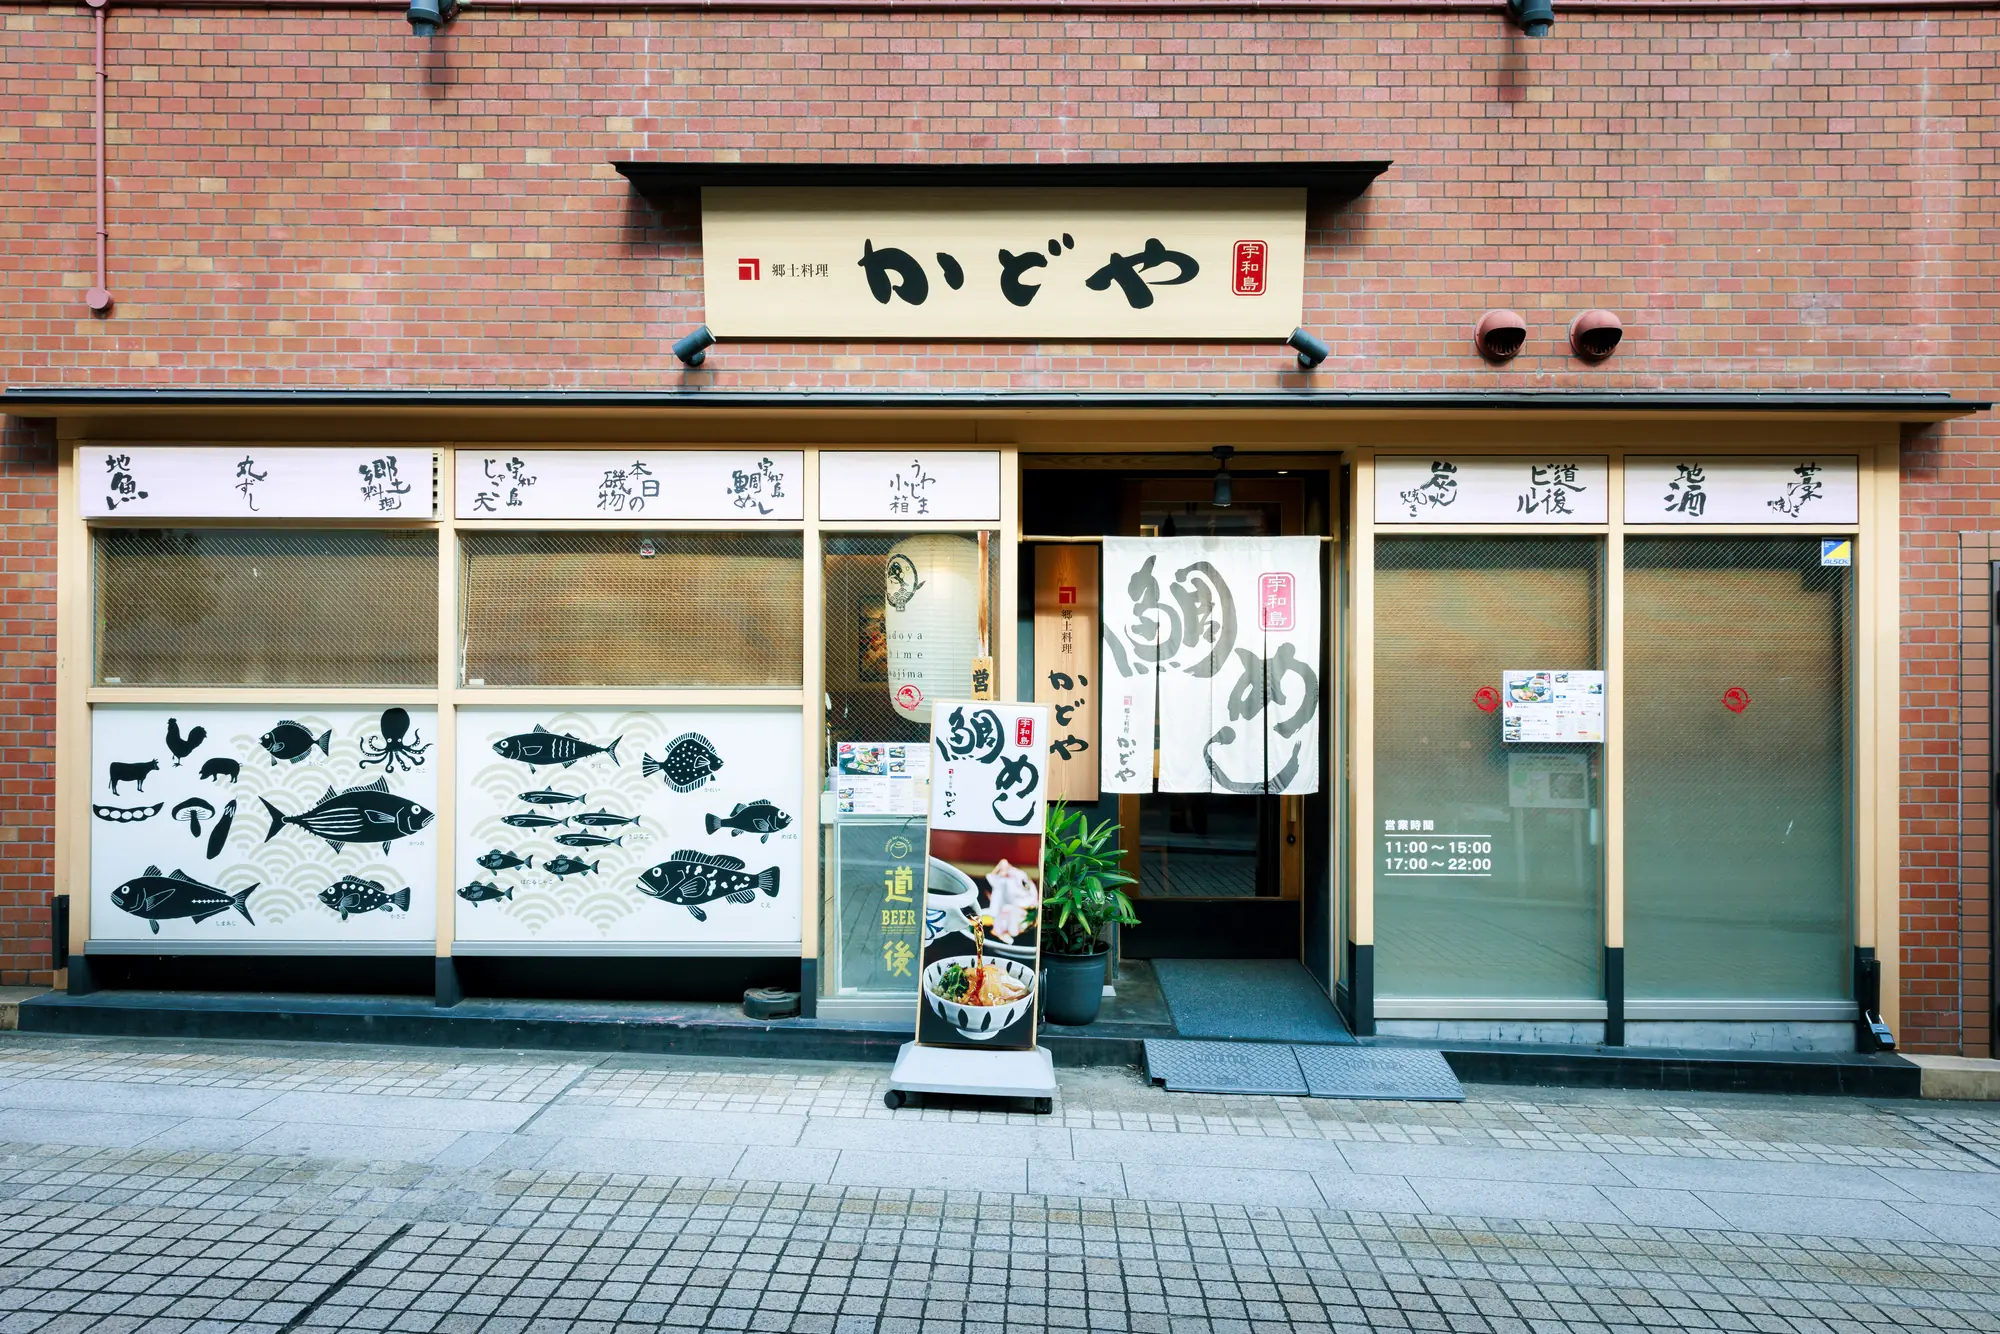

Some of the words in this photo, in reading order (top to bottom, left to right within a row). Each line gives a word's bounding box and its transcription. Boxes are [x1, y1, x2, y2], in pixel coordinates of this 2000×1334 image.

[771, 262, 829, 278] 郷土料理
[858, 232, 1200, 309] かどや
[1239, 242, 1260, 293] 宇和島
[106, 454, 149, 511] 地魚
[235, 455, 268, 512] 丸ずし
[505, 457, 537, 507] 宇和島
[727, 470, 774, 515] 鯛めし
[1663, 462, 1707, 517] 地酒
[1266, 575, 1288, 627] 宇和島
[1061, 608, 1073, 655] 郷土料理
[972, 668, 990, 701] 営
[1048, 669, 1089, 761] かどや
[1114, 736, 1137, 782] かどや
[943, 790, 957, 818] かどや
[1384, 819, 1435, 832] 営業時間
[884, 865, 913, 903] 道
[881, 909, 917, 925] BEER
[883, 940, 915, 977] 後
